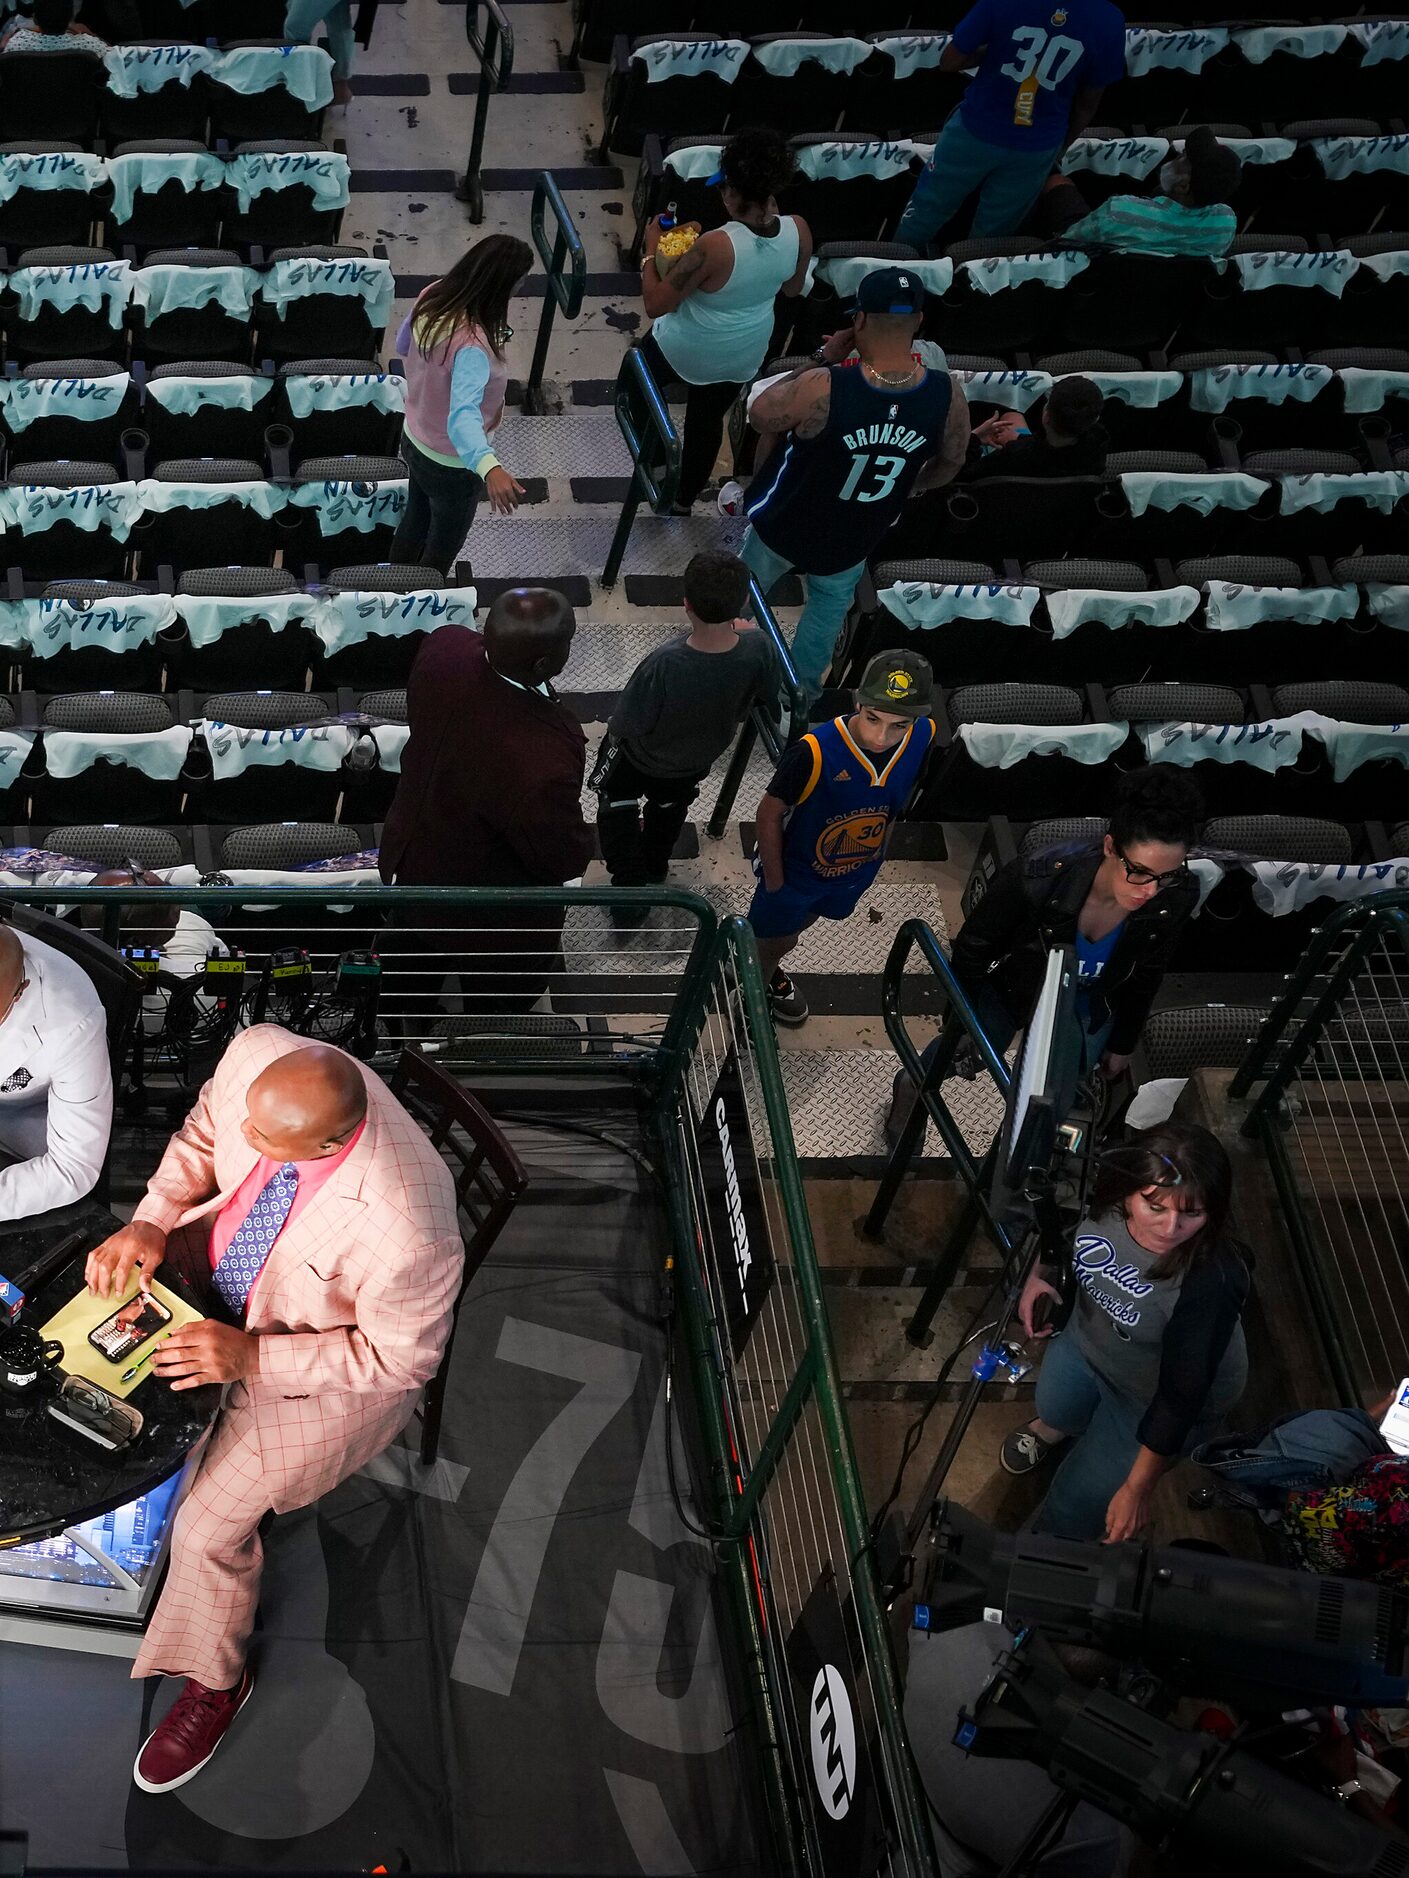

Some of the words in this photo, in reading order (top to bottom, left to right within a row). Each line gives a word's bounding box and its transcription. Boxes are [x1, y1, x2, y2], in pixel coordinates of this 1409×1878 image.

[124, 47, 200, 67] DALLAS
[655, 43, 740, 64] DALLAS
[904, 37, 947, 58] LAS
[1001, 26, 1084, 90] 30
[823, 142, 910, 164] DALLAS
[1066, 141, 1157, 163] DALLAS
[1330, 136, 1409, 162] ALLAS
[5, 155, 87, 182] DALLAS
[249, 154, 332, 179] DALLAS
[288, 262, 380, 286] DALLAS
[1251, 253, 1347, 273] DALLAS
[32, 265, 121, 288] DALLAS
[952, 372, 1044, 391] DALLA
[1213, 365, 1320, 383] DALLAS
[17, 379, 114, 400] DALLAS
[843, 423, 927, 453] BRUNSON
[838, 454, 906, 502] 13
[29, 488, 124, 518] DALLAS
[327, 492, 407, 522] ALLAS
[357, 591, 464, 620] DALLAS
[43, 608, 145, 638] DALLAS
[1161, 723, 1291, 750] DALLAS
[825, 806, 876, 824] GOLDEN
[857, 822, 884, 840] 30
[811, 860, 863, 878] WARRIO
[1075, 1234, 1154, 1299] Dallas
[1072, 1258, 1141, 1327] Mavericks
[814, 1666, 851, 1811] TNT
